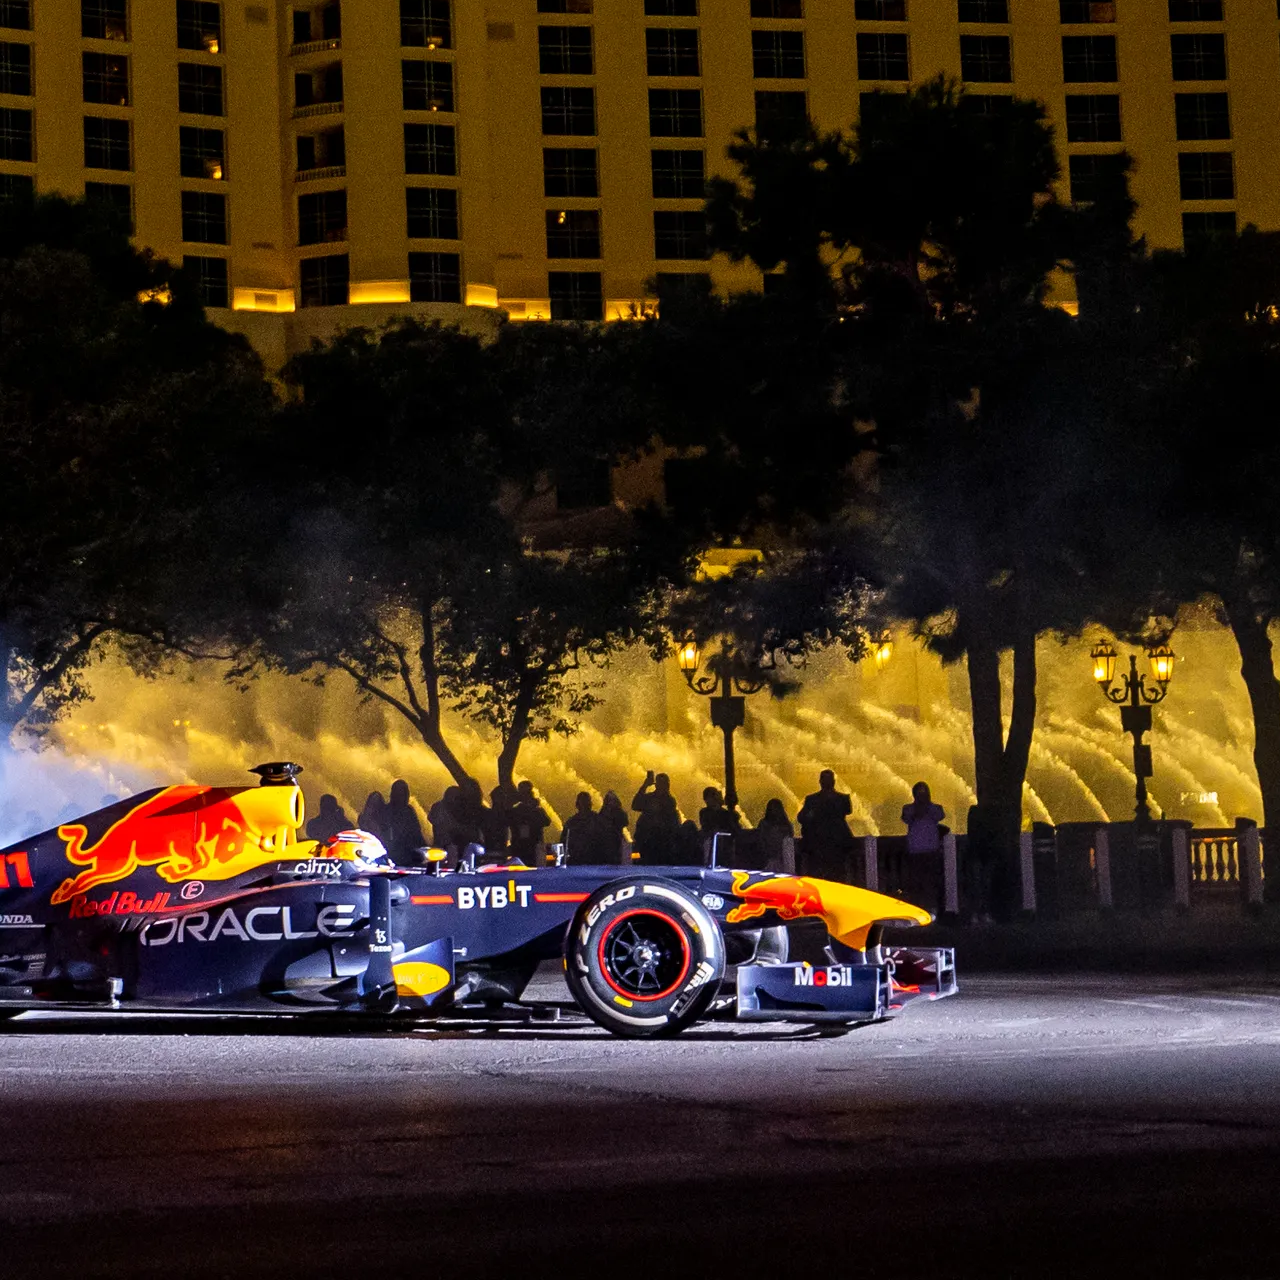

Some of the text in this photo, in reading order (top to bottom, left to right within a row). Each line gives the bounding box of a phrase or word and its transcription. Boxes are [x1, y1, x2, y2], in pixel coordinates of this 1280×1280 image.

[294, 858, 343, 877] citrix
[457, 879, 532, 909] BYBIT
[139, 904, 356, 946] ORACLE
[579, 885, 637, 946] ZERO
[794, 967, 852, 987] Mobil
